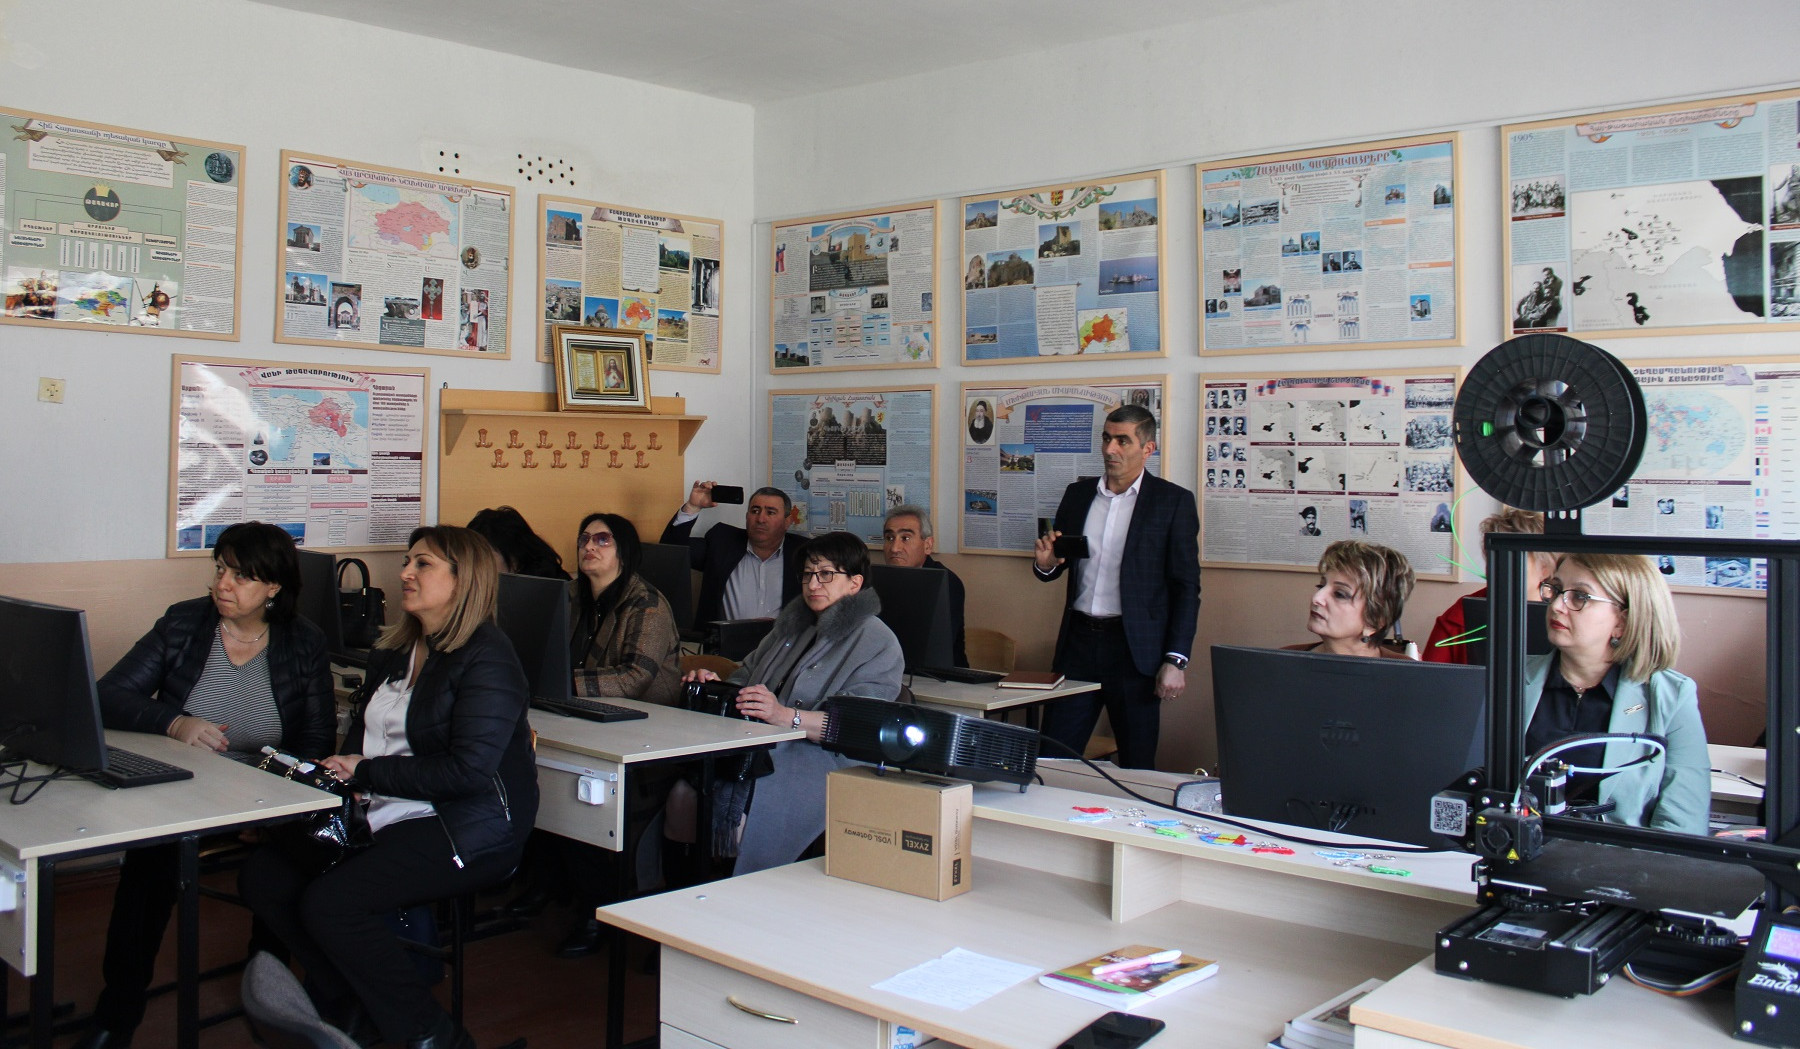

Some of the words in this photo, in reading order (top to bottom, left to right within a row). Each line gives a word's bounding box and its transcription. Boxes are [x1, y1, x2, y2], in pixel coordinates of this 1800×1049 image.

[38, 121, 53, 130] Հին
[55, 124, 101, 138] Հայաստանի
[103, 133, 141, 144] պետական
[142, 139, 167, 149] կարգը
[1512, 133, 1534, 142] 1905
[1256, 162, 1305, 176] ՀԱՅԿԱԿԱՆ
[1308, 152, 1390, 170] ԳԱՂԹԱՎԱՅՐԵՐԸ
[260, 370, 282, 379] ՎԱՆԻ
[285, 368, 355, 384] ԹԱԳԱՎՈՐՈՒԹՅՈՒՆ
[1633, 366, 1724, 375] ՑԵՂԱՍՊԱՆՈՒԹՅԱՆ
[1005, 388, 1051, 406] ՄԽԻԹԱՐՅԱՆ
[1051, 387, 1114, 404] ՄԻԱԲԱՆՈՒԹՅՈՒՆ
[844, 828, 873, 841] Gateway
[873, 834, 892, 845] VDSL
[905, 839, 930, 852] ZYXEL
